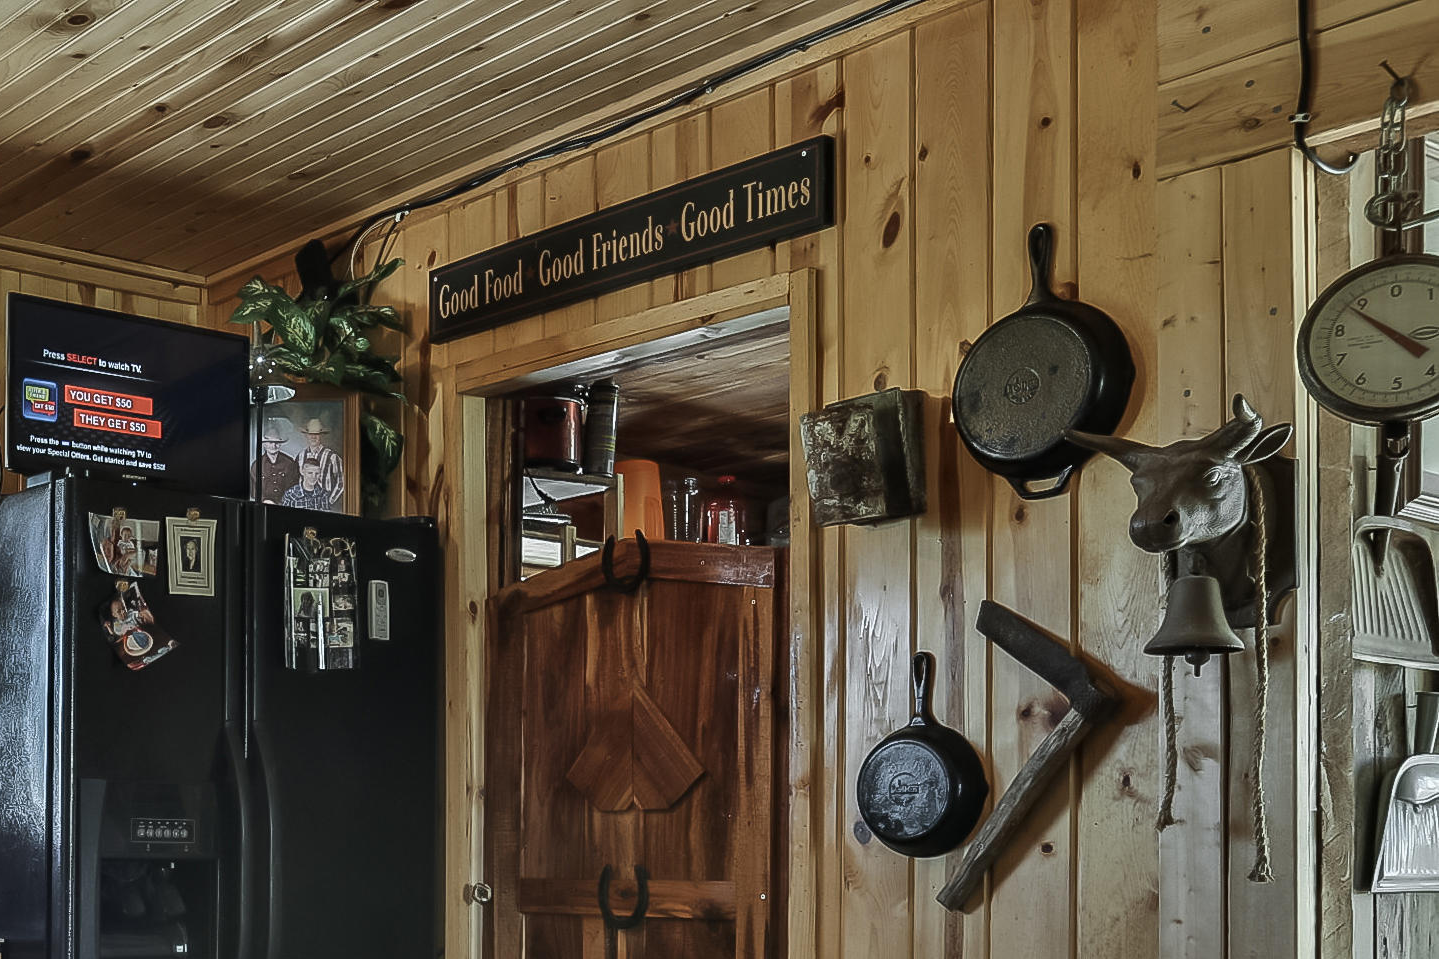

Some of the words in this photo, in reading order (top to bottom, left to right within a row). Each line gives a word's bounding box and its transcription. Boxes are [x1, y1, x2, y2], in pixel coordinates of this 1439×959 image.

[439, 274, 479, 319] Good
[485, 258, 523, 304] Food
[539, 238, 585, 287] Good
[591, 215, 664, 271] Friends
[681, 188, 735, 242] Good
[742, 177, 811, 223] Times
[1390, 284, 1402, 298] 0
[1427, 287, 1434, 300] 1
[1357, 298, 1368, 310] 9
[1335, 324, 1345, 337] 8
[42, 348, 65, 361] Press
[66, 352, 98, 365] SELECT
[98, 358, 107, 368] to
[108, 361, 130, 372] watch
[1336, 353, 1347, 366] 7
[1425, 364, 1435, 376] 4
[1355, 372, 1366, 385] 6
[1391, 377, 1402, 390] 5
[69, 390, 91, 402] YOU
[93, 393, 113, 406] GET
[115, 397, 132, 409] $50
[79, 413, 106, 427] THEY
[107, 418, 127, 430] GET
[129, 422, 146, 433] $50
[29, 434, 48, 444] Press
[48, 436, 60, 446] the
[71, 440, 92, 450] button
[92, 444, 109, 453] while
[109, 446, 136, 458] watching
[136, 449, 145, 458] TV
[145, 451, 152, 459] to
[16, 444, 31, 452] view
[32, 445, 46, 455] your
[47, 448, 70, 457] Special
[92, 453, 103, 463] Get
[104, 456, 125, 466] started
[125, 459, 137, 467] and
[138, 461, 152, 469] save
